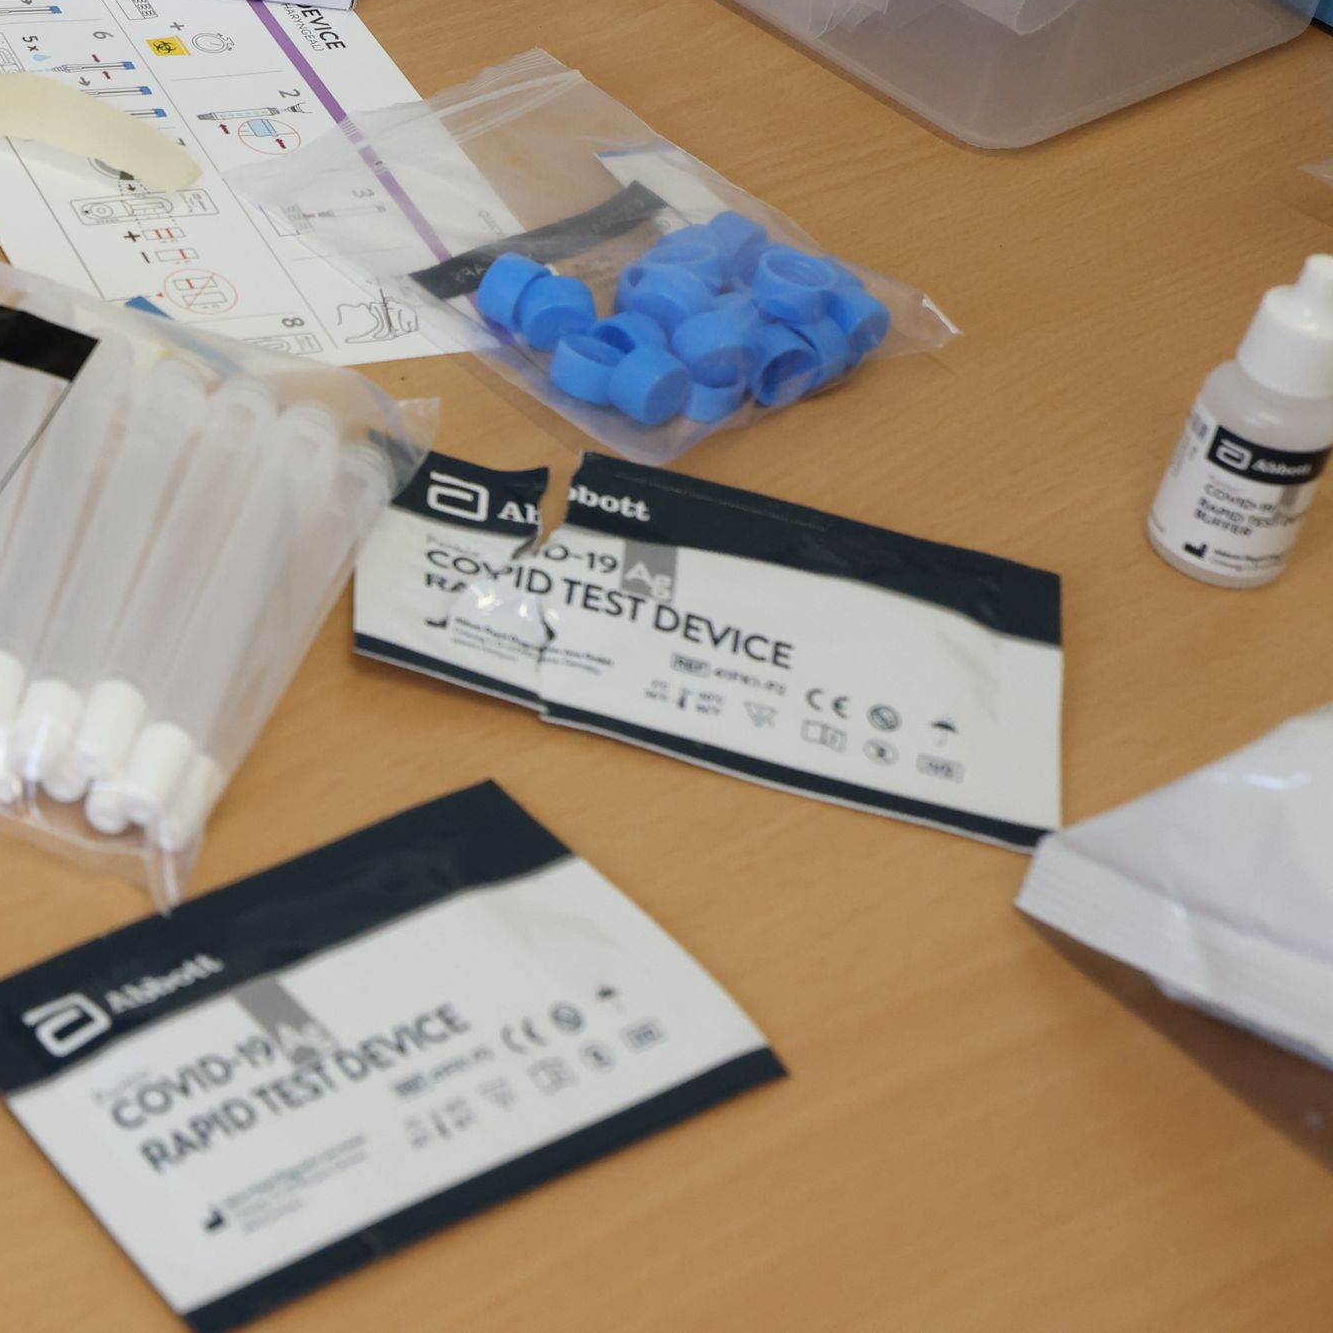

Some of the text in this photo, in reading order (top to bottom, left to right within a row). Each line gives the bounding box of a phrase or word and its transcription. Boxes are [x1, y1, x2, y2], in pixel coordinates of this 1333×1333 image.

[278, 88, 301, 99] 2
[282, 316, 305, 329] 8
[1250, 456, 1313, 477] Abbott
[623, 560, 673, 604] Ag
[560, 577, 646, 622] TEST
[652, 603, 795, 670] DEVICE
[105, 954, 225, 1014] Abbott
[111, 1035, 276, 1130] COVID-19
[139, 1098, 258, 1175] RAPID
[252, 1062, 337, 1116] TEST
[333, 1002, 473, 1082] DEVICE
